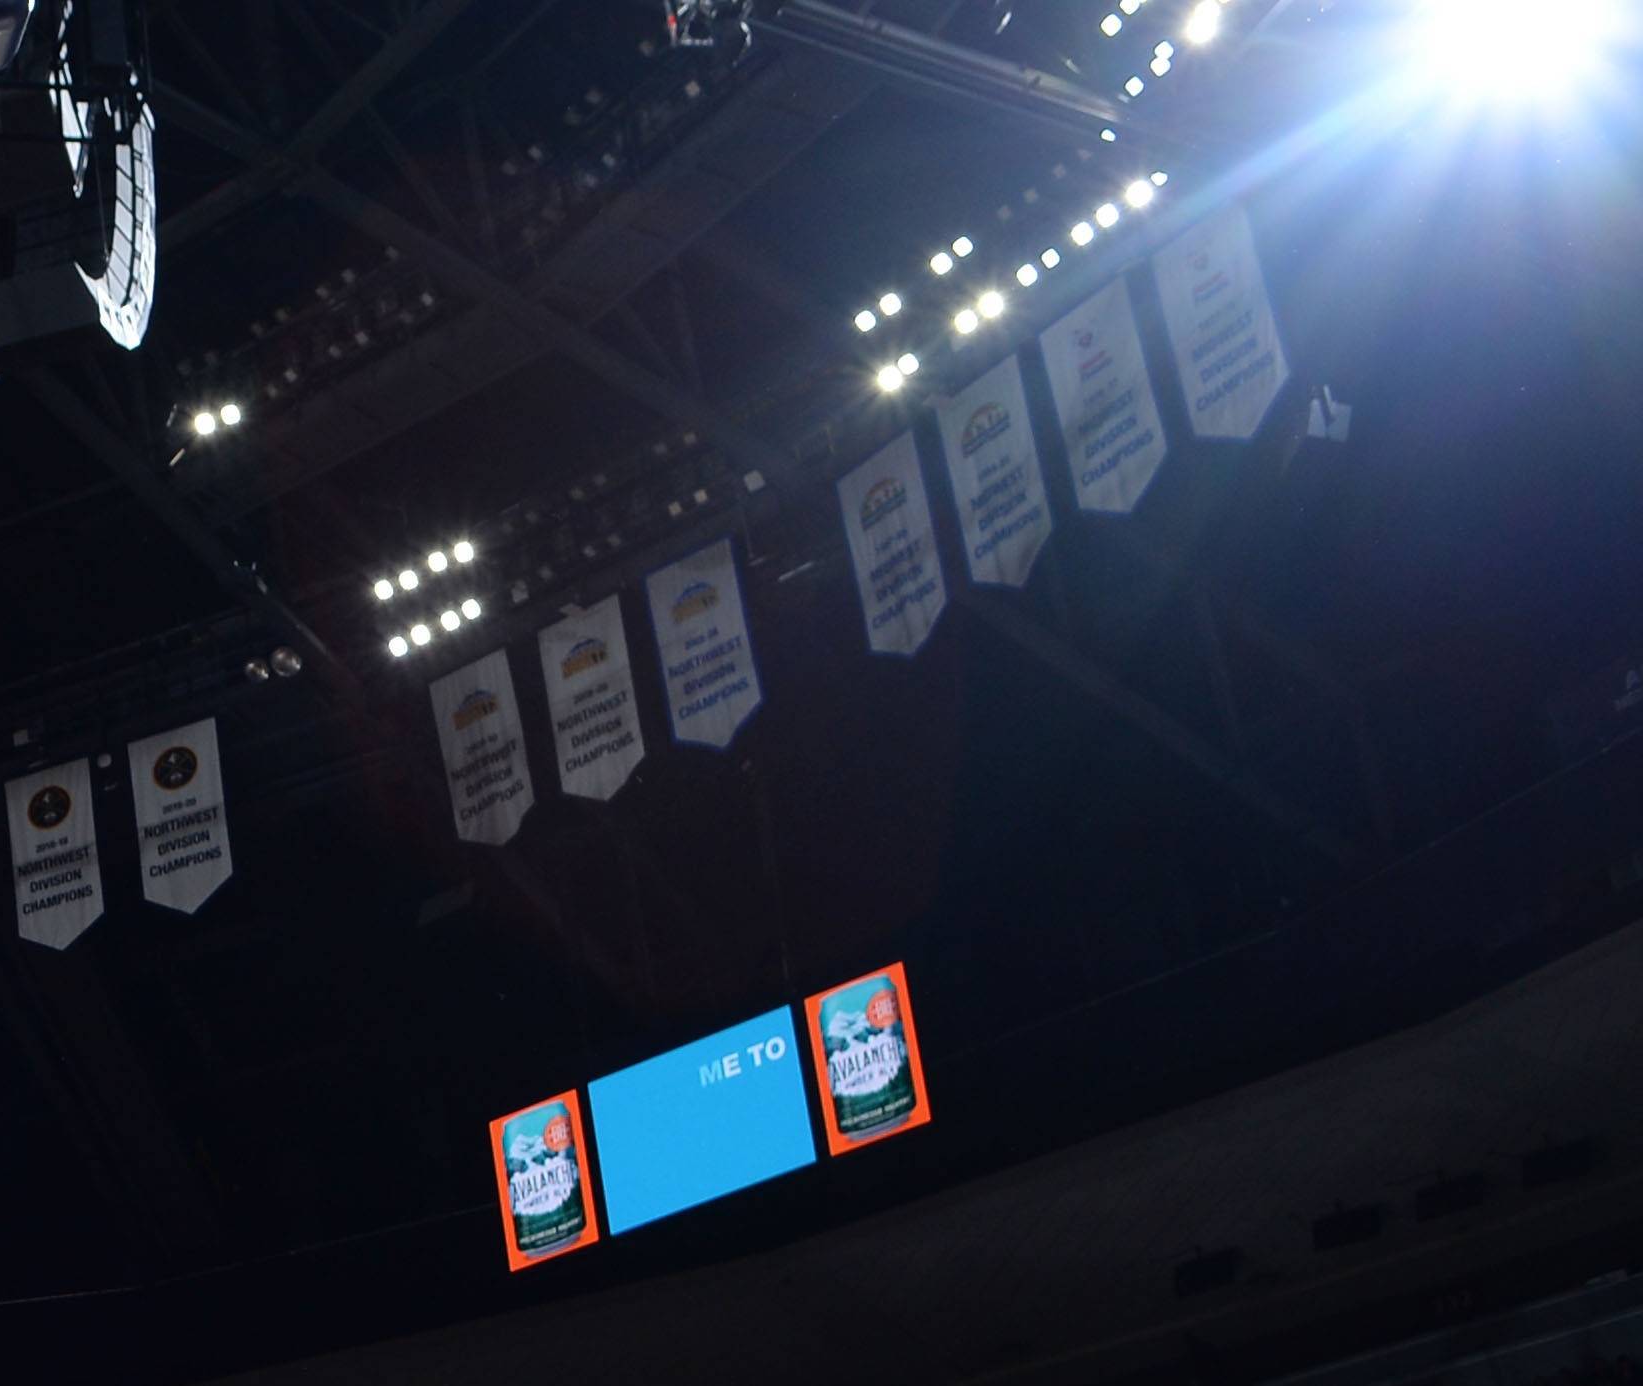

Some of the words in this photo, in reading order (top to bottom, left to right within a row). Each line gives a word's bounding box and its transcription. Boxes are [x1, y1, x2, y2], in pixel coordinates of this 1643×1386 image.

[679, 676, 749, 720] CHAMPIONS
[143, 806, 219, 839] NORTHWEST
[157, 830, 210, 856] DIVISION
[17, 847, 90, 877] NORTHWEST
[149, 846, 222, 877] CHAMPIONS
[30, 868, 82, 893] DIVISION
[23, 884, 93, 915] CHAMPIONS
[746, 1037, 786, 1067] TO
